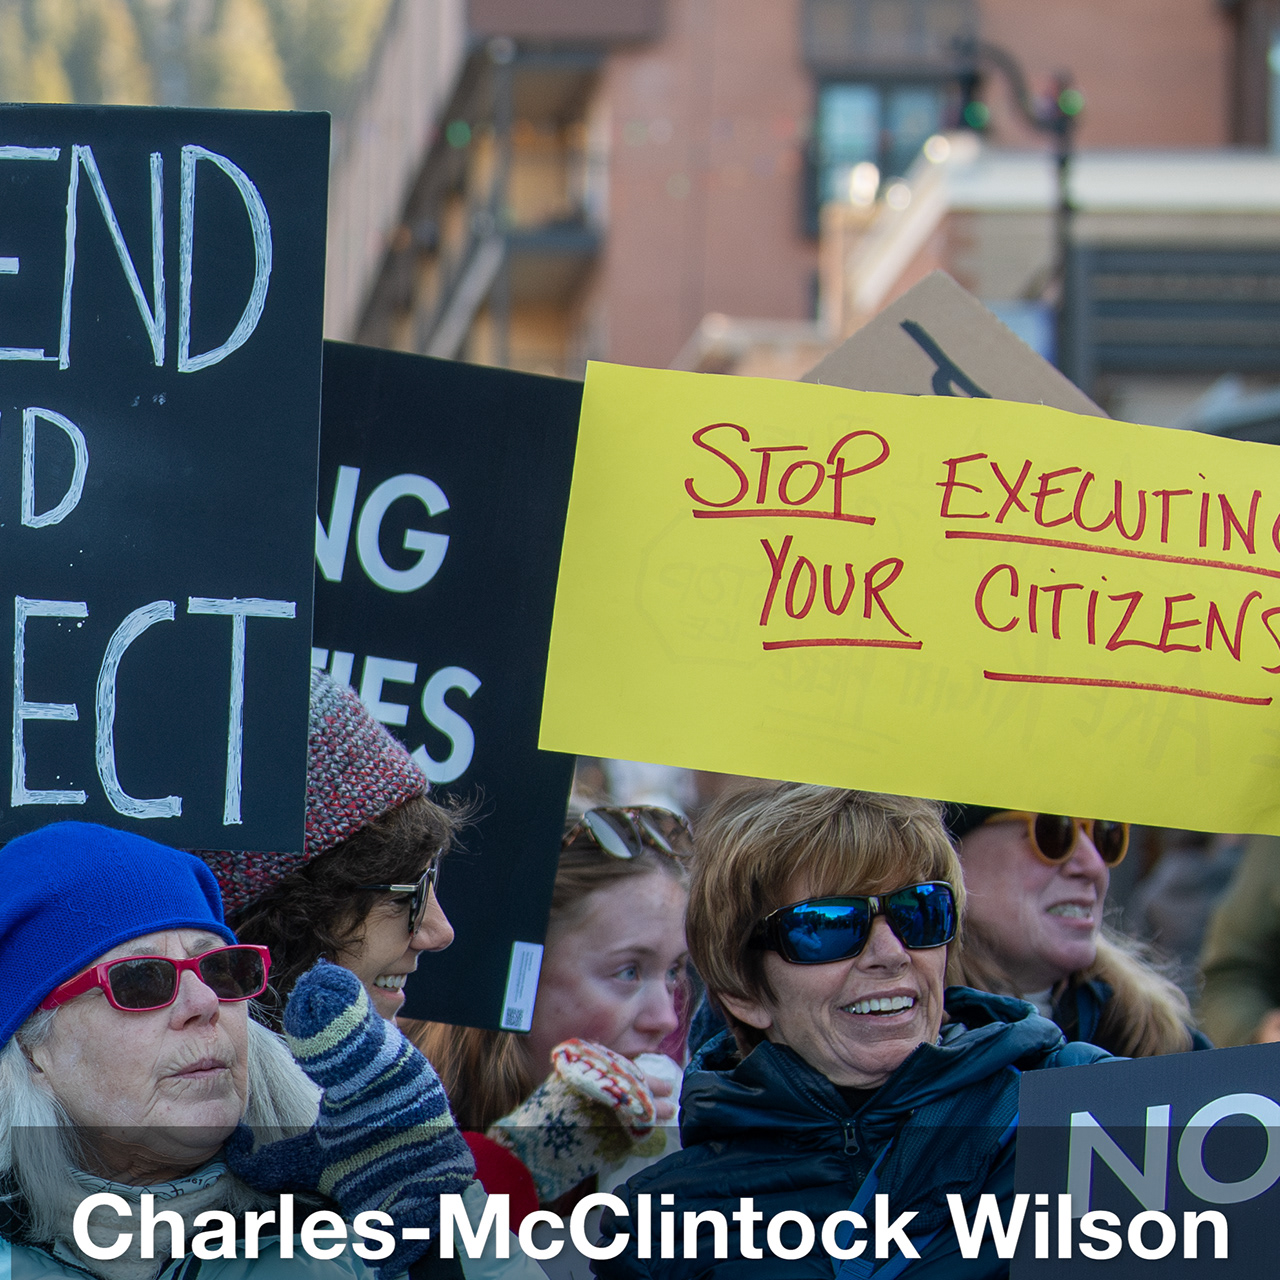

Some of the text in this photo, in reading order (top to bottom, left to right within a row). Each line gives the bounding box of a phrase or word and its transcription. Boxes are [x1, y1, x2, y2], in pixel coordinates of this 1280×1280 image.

[685, 423, 890, 518] STOP
[936, 453, 1280, 555] EXECUTIN
[760, 534, 912, 638] YOUR
